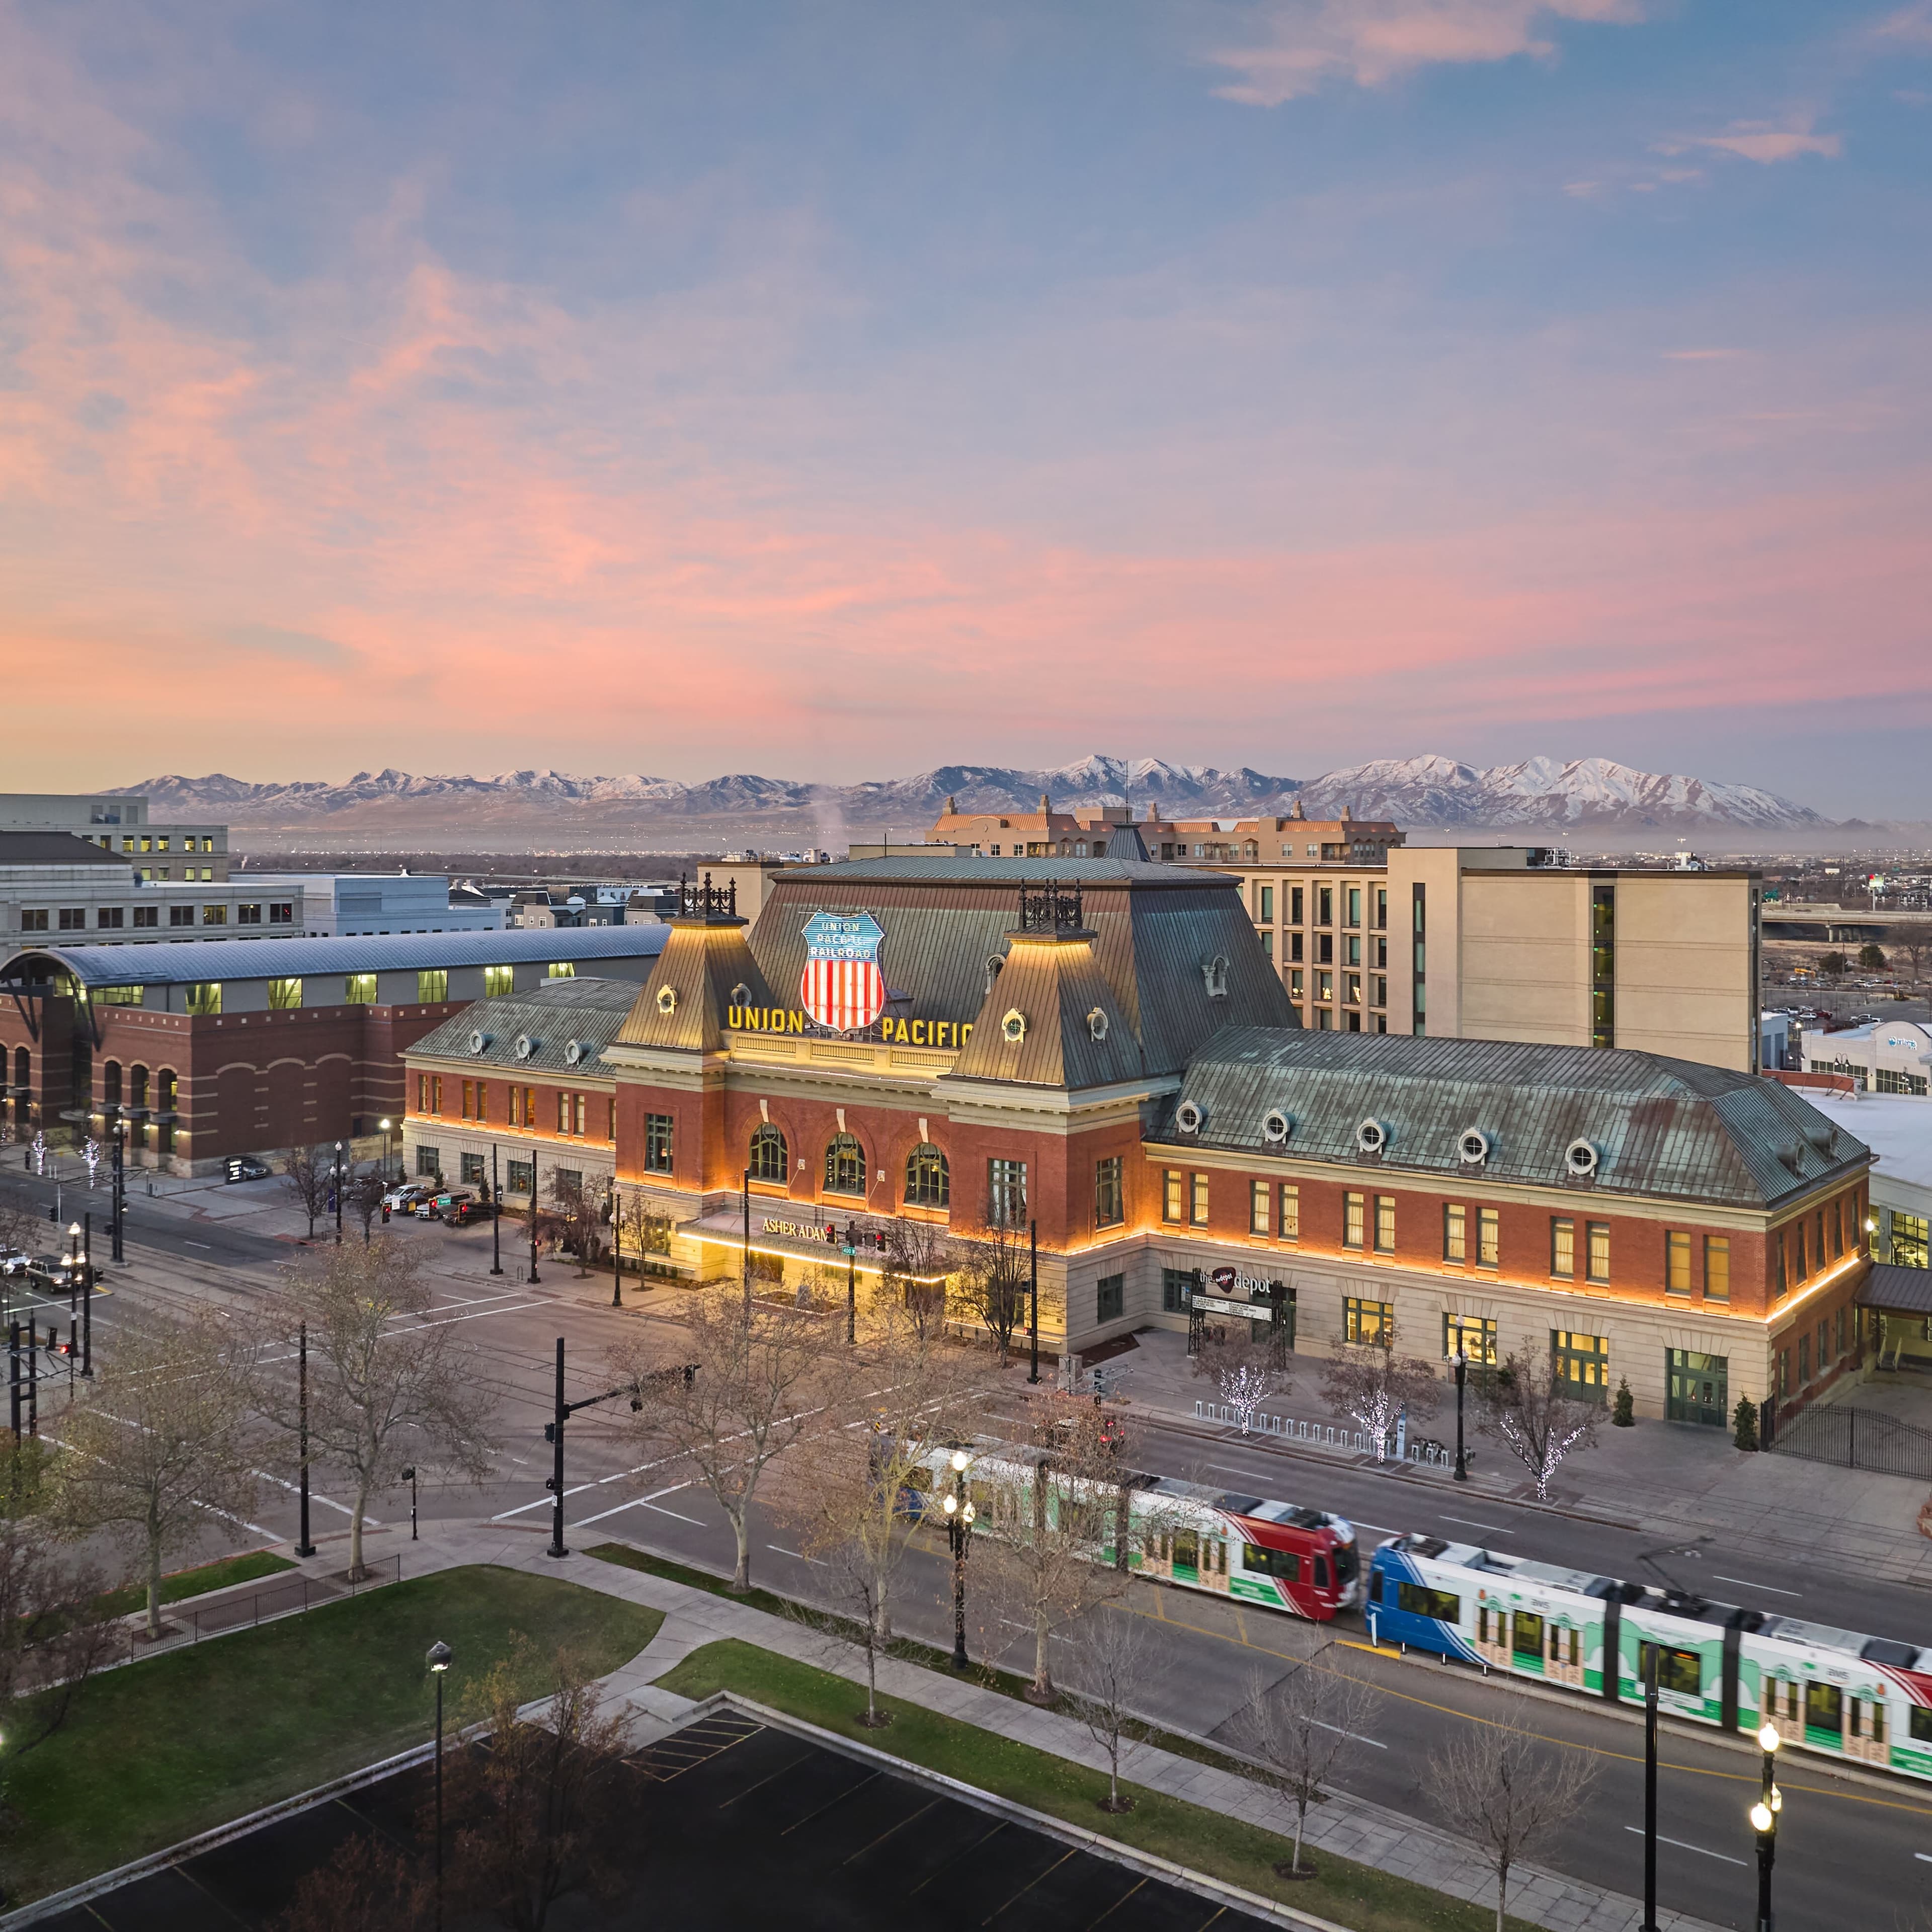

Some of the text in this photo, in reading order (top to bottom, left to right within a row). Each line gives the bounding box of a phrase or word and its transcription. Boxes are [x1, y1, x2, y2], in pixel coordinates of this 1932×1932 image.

[822, 922, 859, 931] UNION
[817, 934, 865, 945] PACIFIC
[811, 947, 870, 958] RAILROAD
[729, 1005, 802, 1033] UNION
[762, 1218, 837, 1244] ASHER ADAM
[1200, 1271, 1270, 1295] the depot
